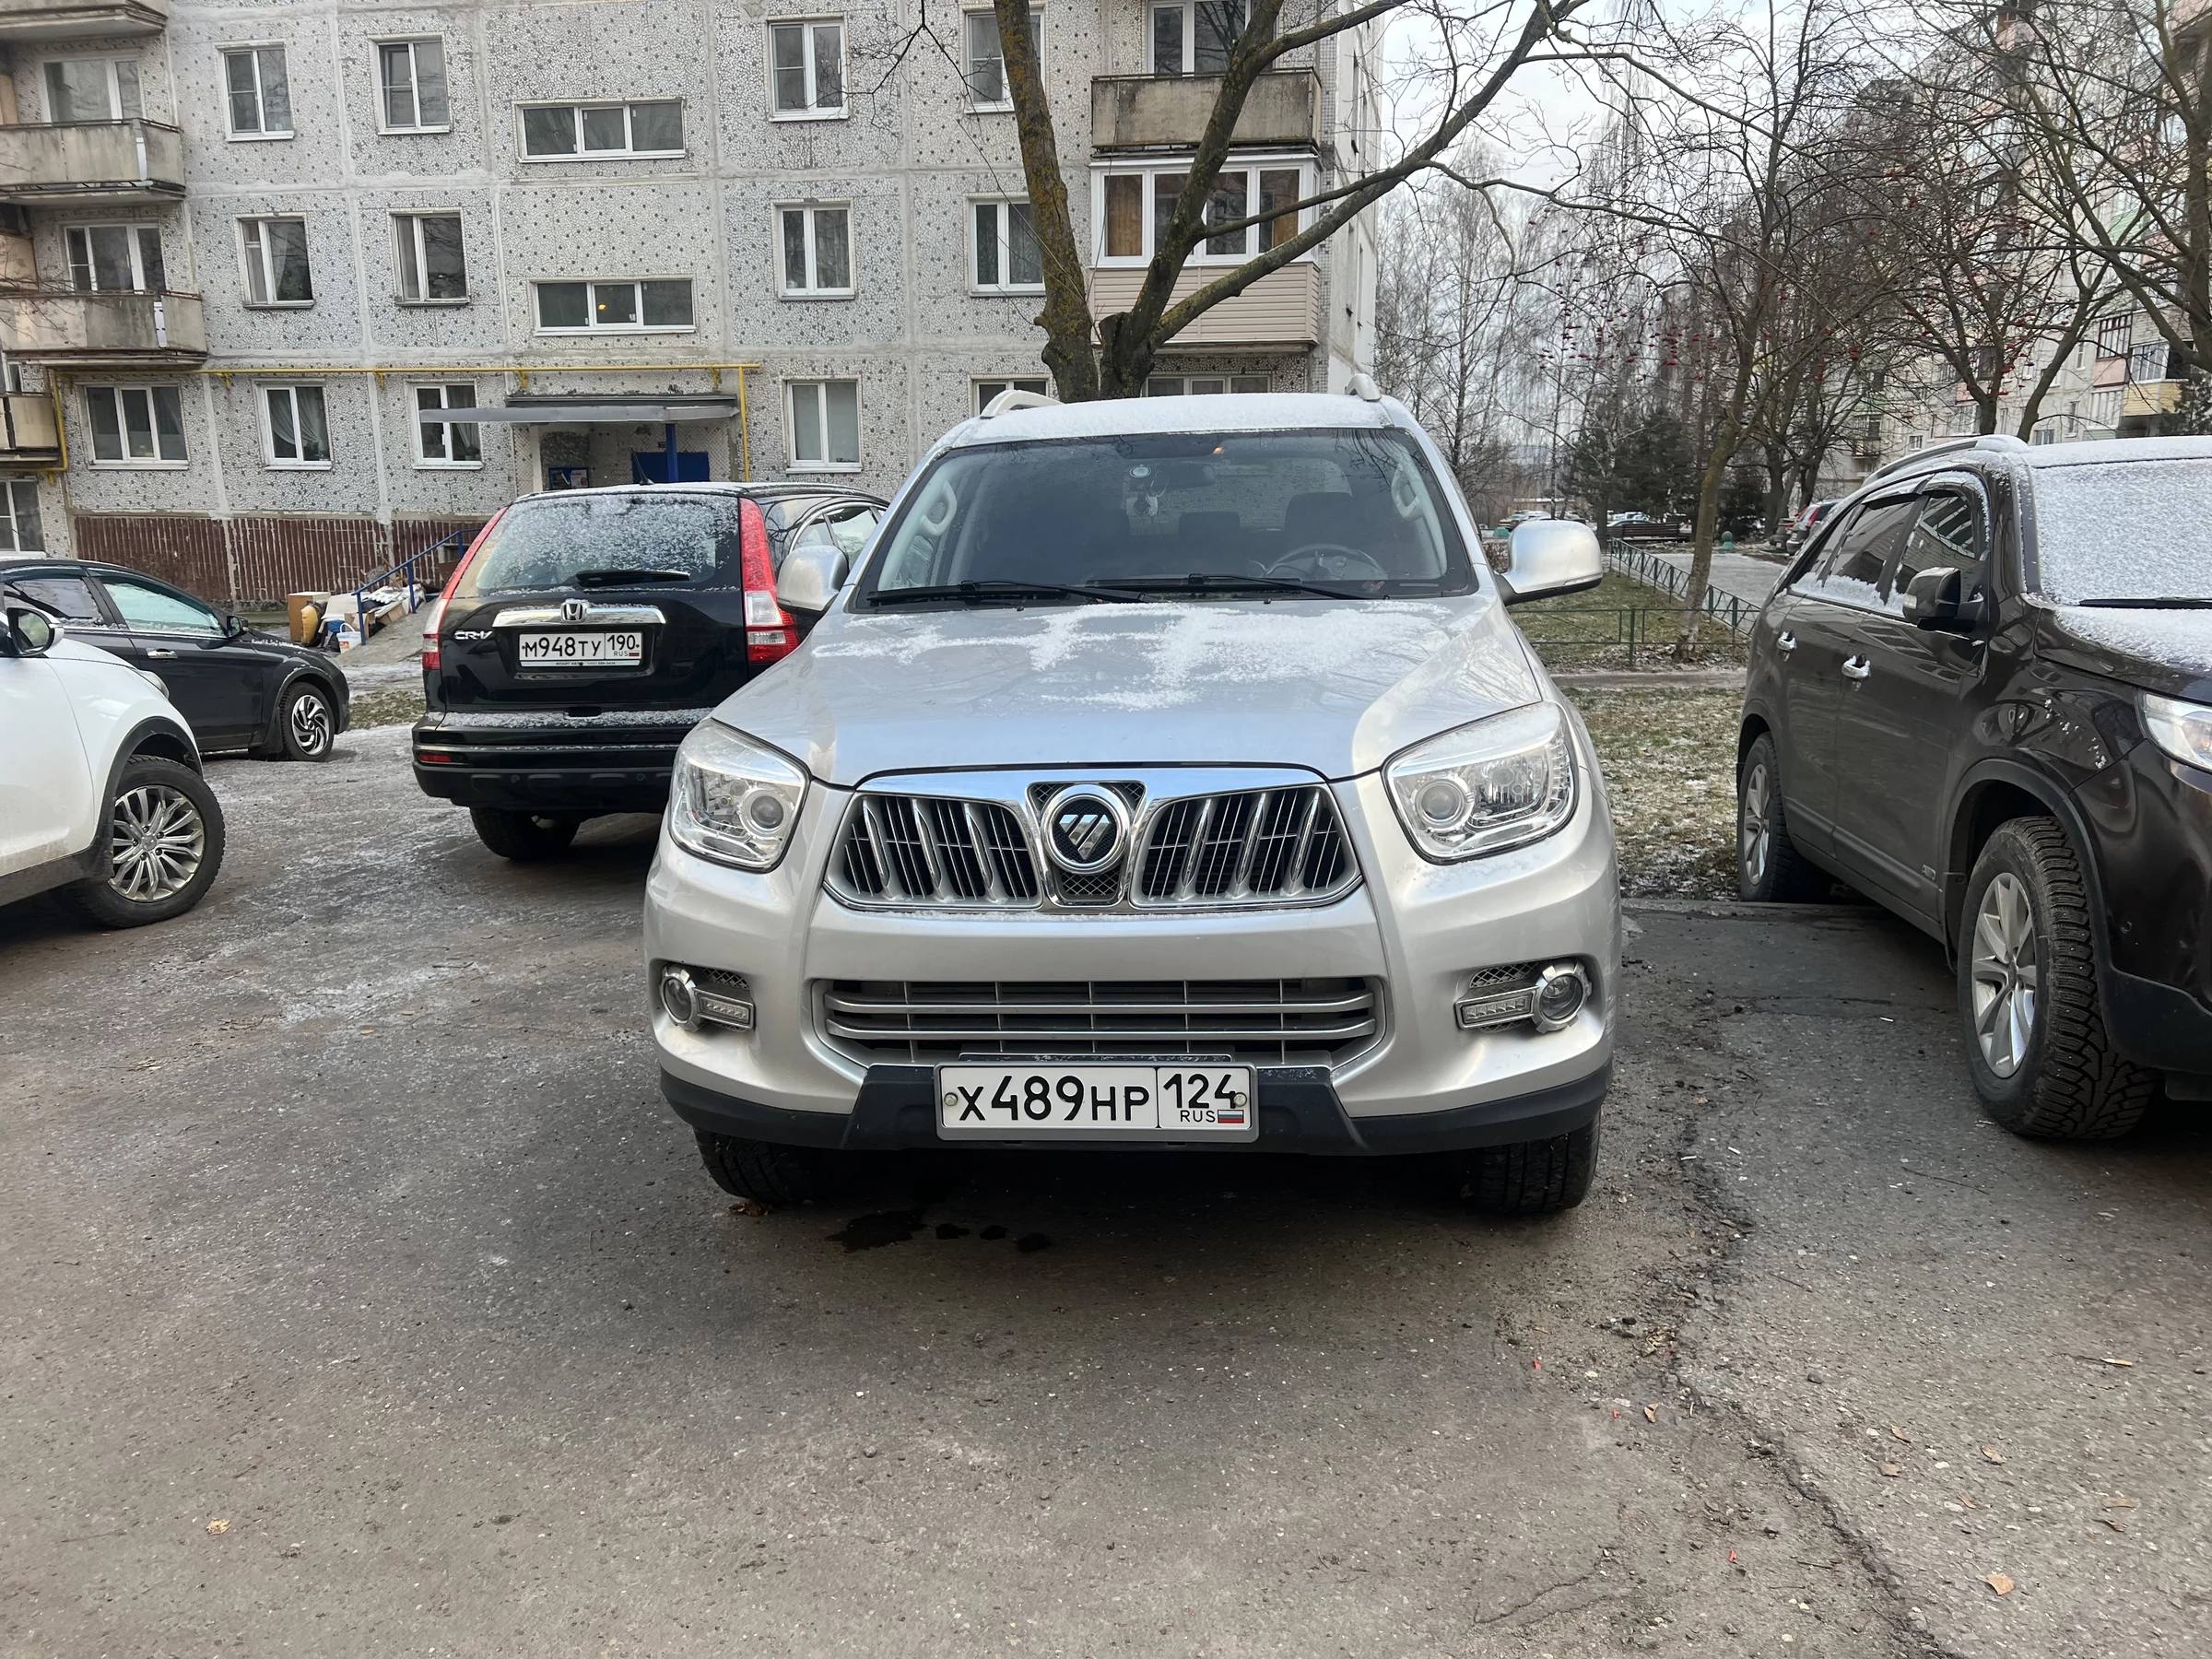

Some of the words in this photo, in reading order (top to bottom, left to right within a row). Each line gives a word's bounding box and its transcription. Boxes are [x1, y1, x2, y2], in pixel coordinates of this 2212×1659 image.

[453, 629, 493, 641] CR-V
[606, 634, 636, 651] 190
[1162, 1073, 1237, 1109] 124
[1180, 1110, 1216, 1123] RUS
